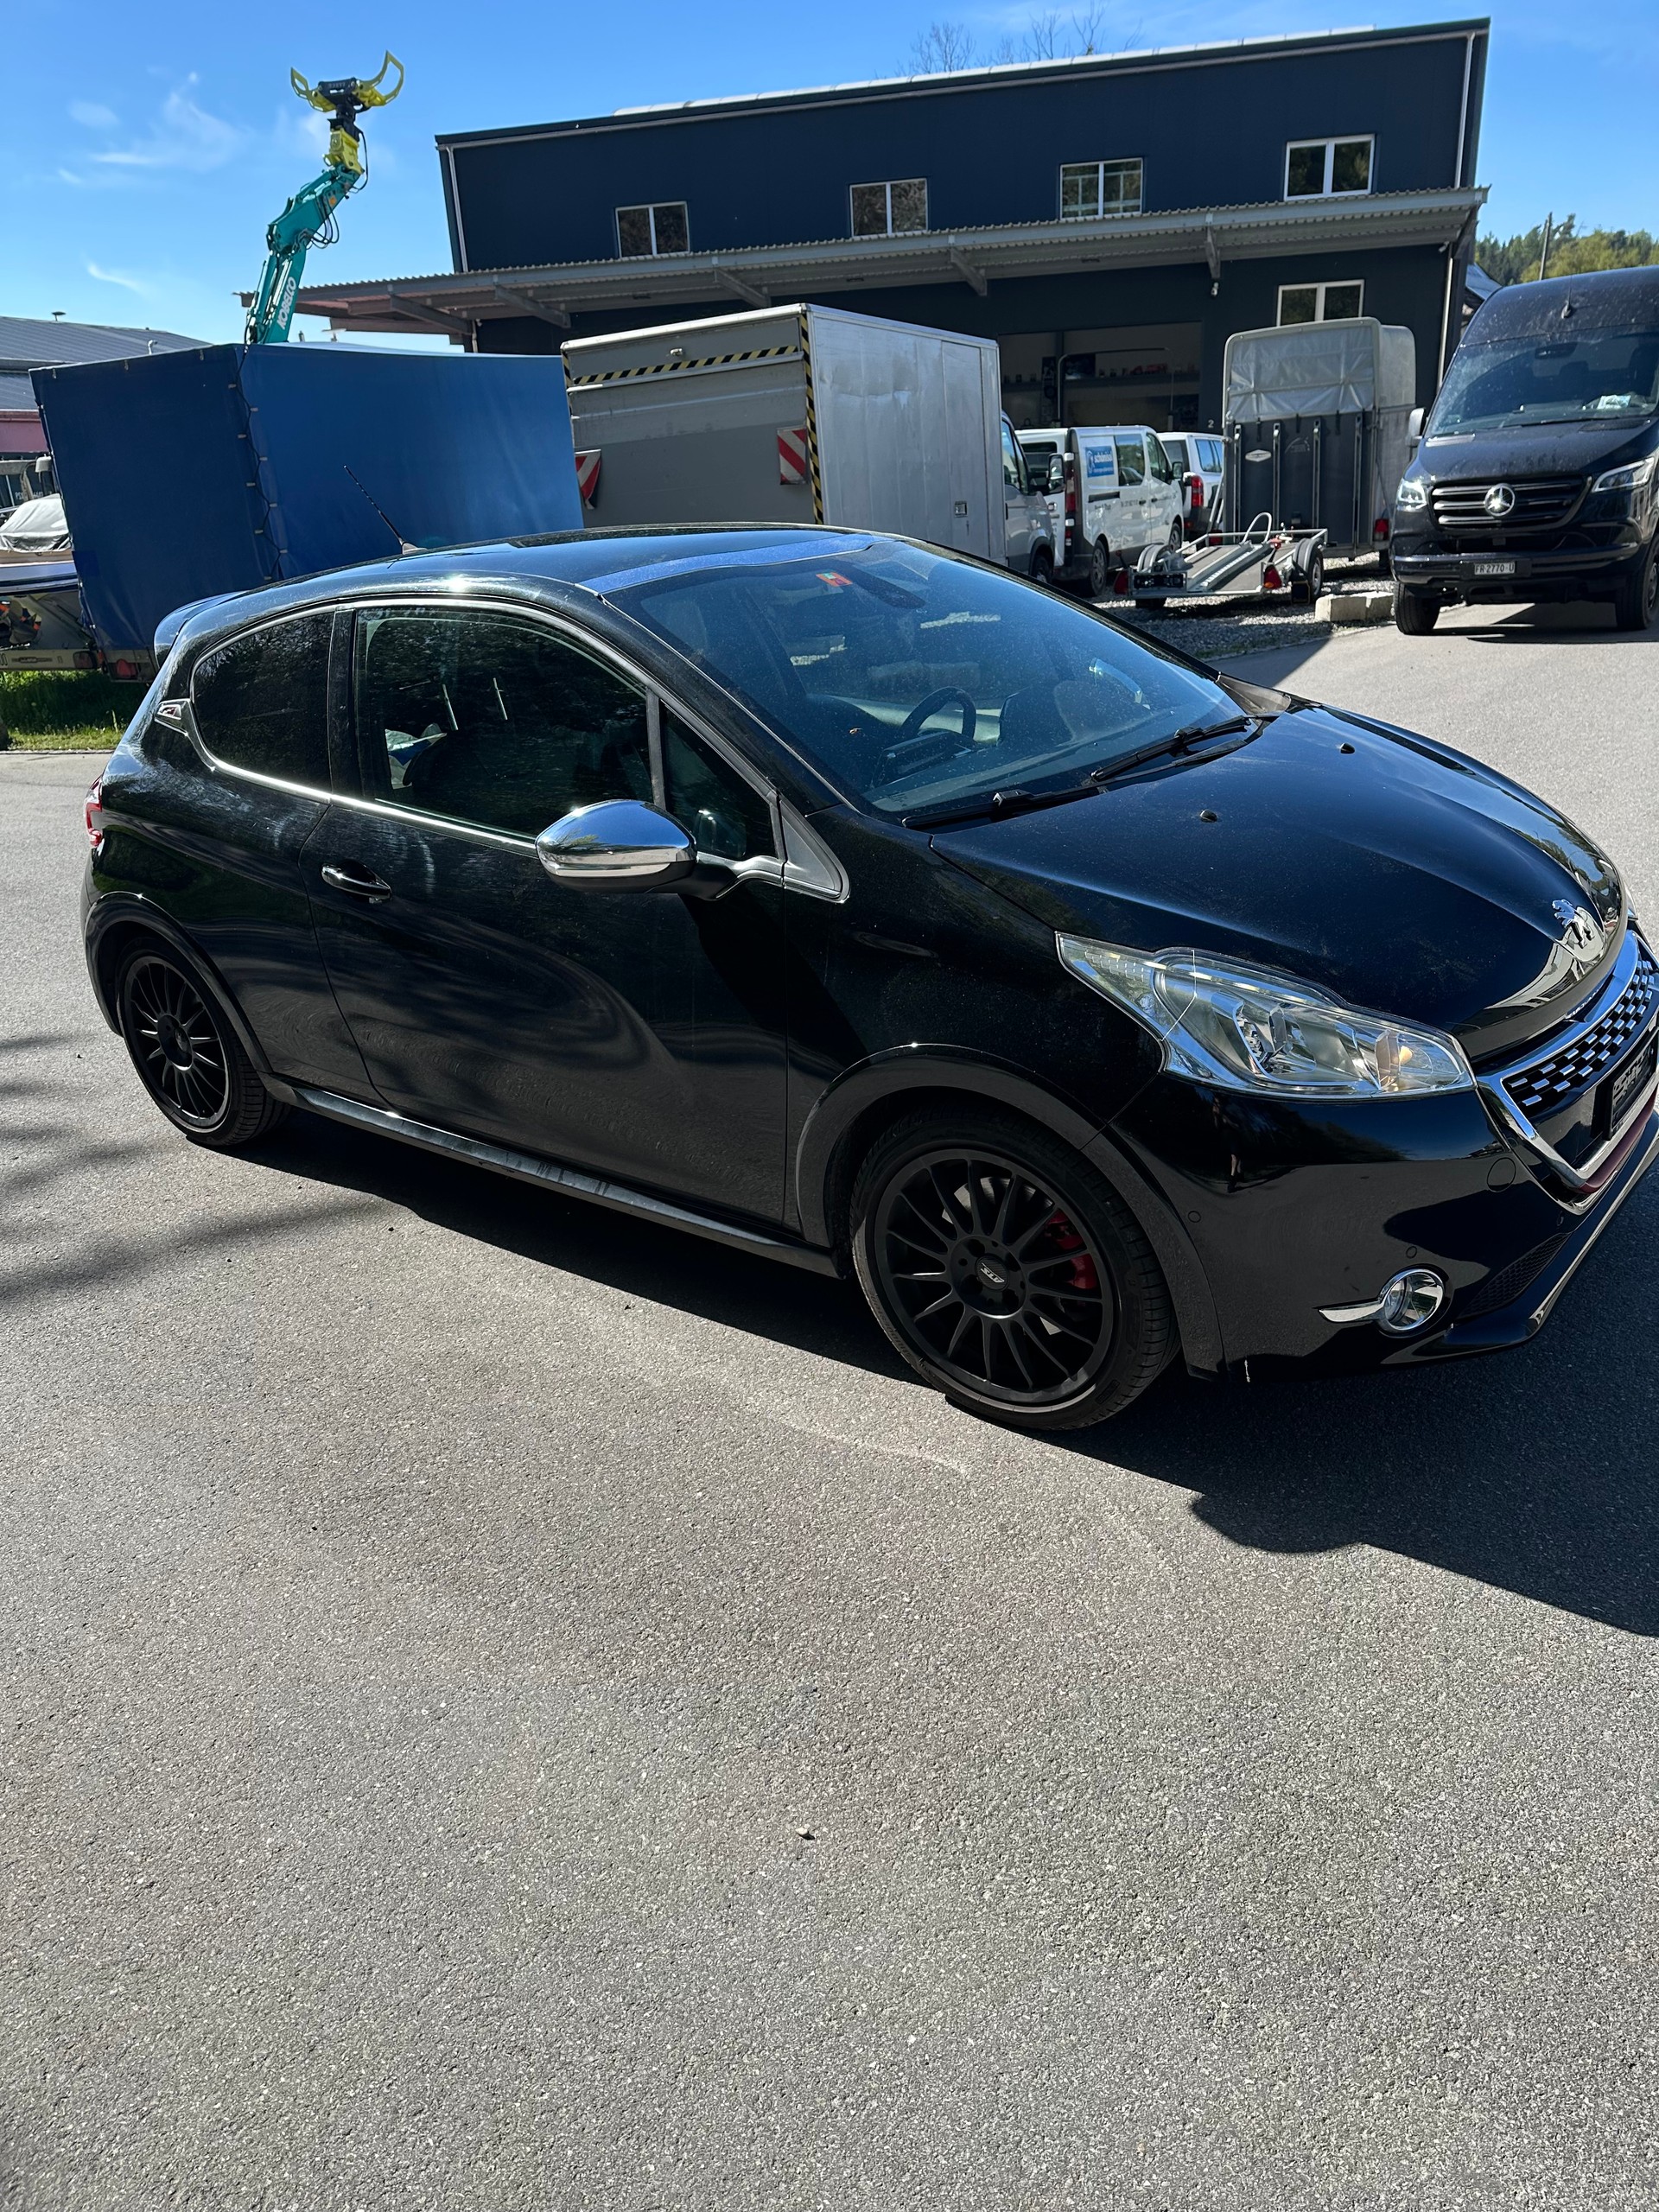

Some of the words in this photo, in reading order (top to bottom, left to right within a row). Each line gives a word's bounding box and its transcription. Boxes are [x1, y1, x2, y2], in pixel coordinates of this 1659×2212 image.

[276, 276, 296, 330] KOBELCO
[1208, 419, 1215, 429] 2
[1486, 563, 1505, 574] 2770
[980, 1262, 1005, 1283] ATS
